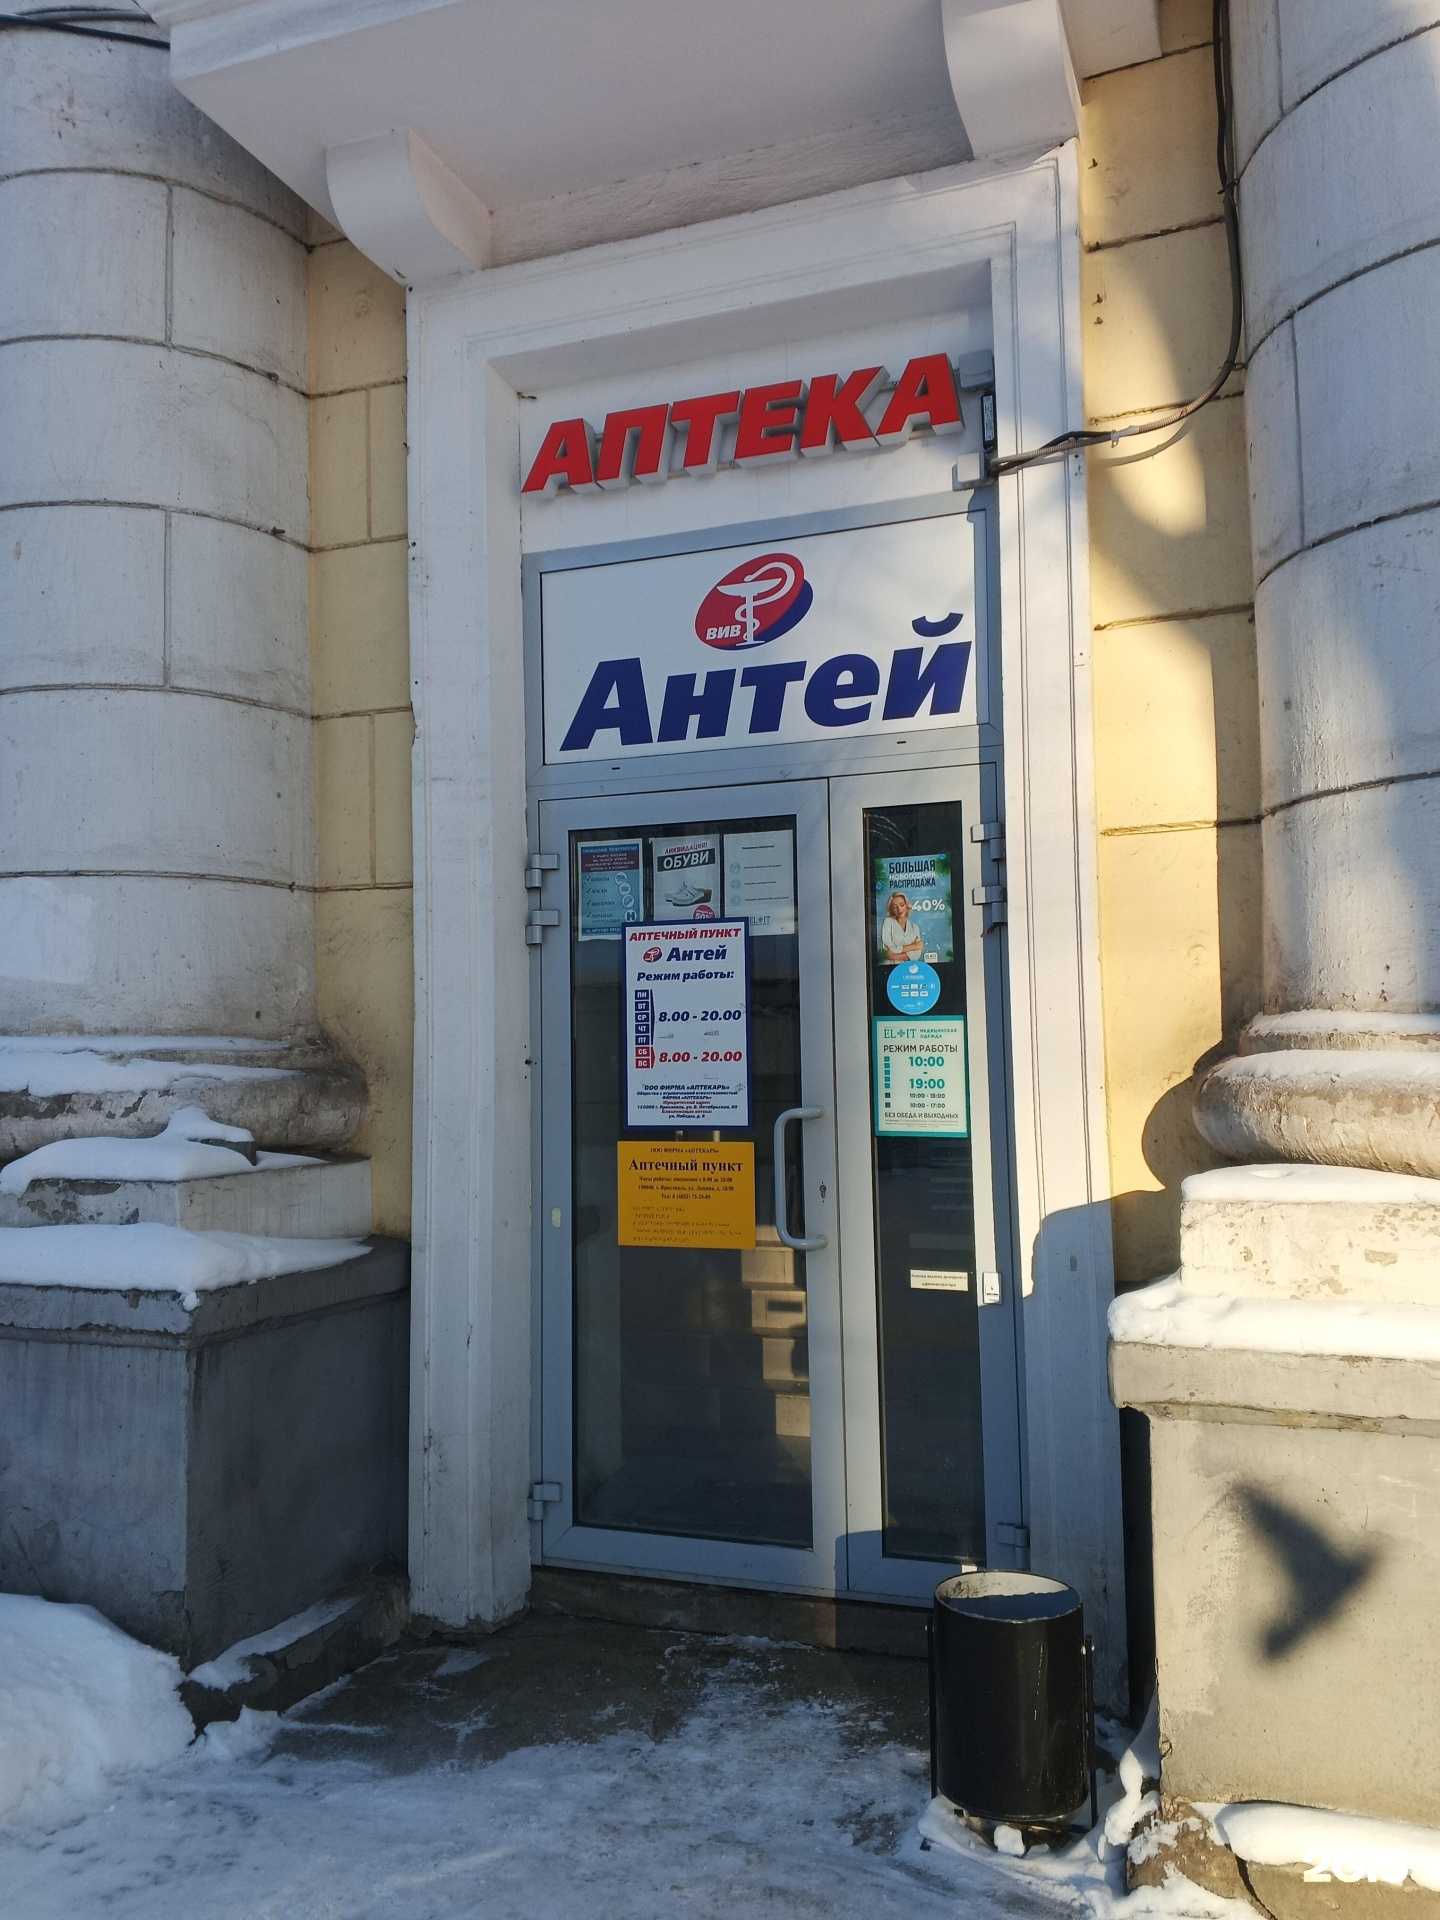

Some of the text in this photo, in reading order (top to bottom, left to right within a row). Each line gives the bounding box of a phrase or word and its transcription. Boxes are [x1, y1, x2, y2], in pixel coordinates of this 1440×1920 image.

[521, 353, 964, 496] АПТЕКА
[706, 624, 742, 640] ВИВ
[559, 612, 973, 752] Антей
[663, 850, 709, 870] ОБУВИ
[889, 859, 936, 873] БОЛЬШАЯ
[889, 878, 936, 888] РАСПРОДАЖА
[629, 928, 698, 942] АПТЕЧНЫЙ
[699, 928, 742, 938] ПУНКТ
[666, 945, 728, 962] Антей
[636, 970, 735, 982] Режим работы:
[658, 1011, 690, 1022] 8.00
[700, 1010, 742, 1021] 20.00
[883, 1044, 958, 1053] РЕЖИМ РАБОТЫ
[659, 1052, 691, 1063] 8.00
[701, 1051, 743, 1062] 20.00
[909, 1056, 945, 1067] 10:00
[909, 1078, 945, 1089] 19:00
[628, 1159, 744, 1175] Аптечный пункт
